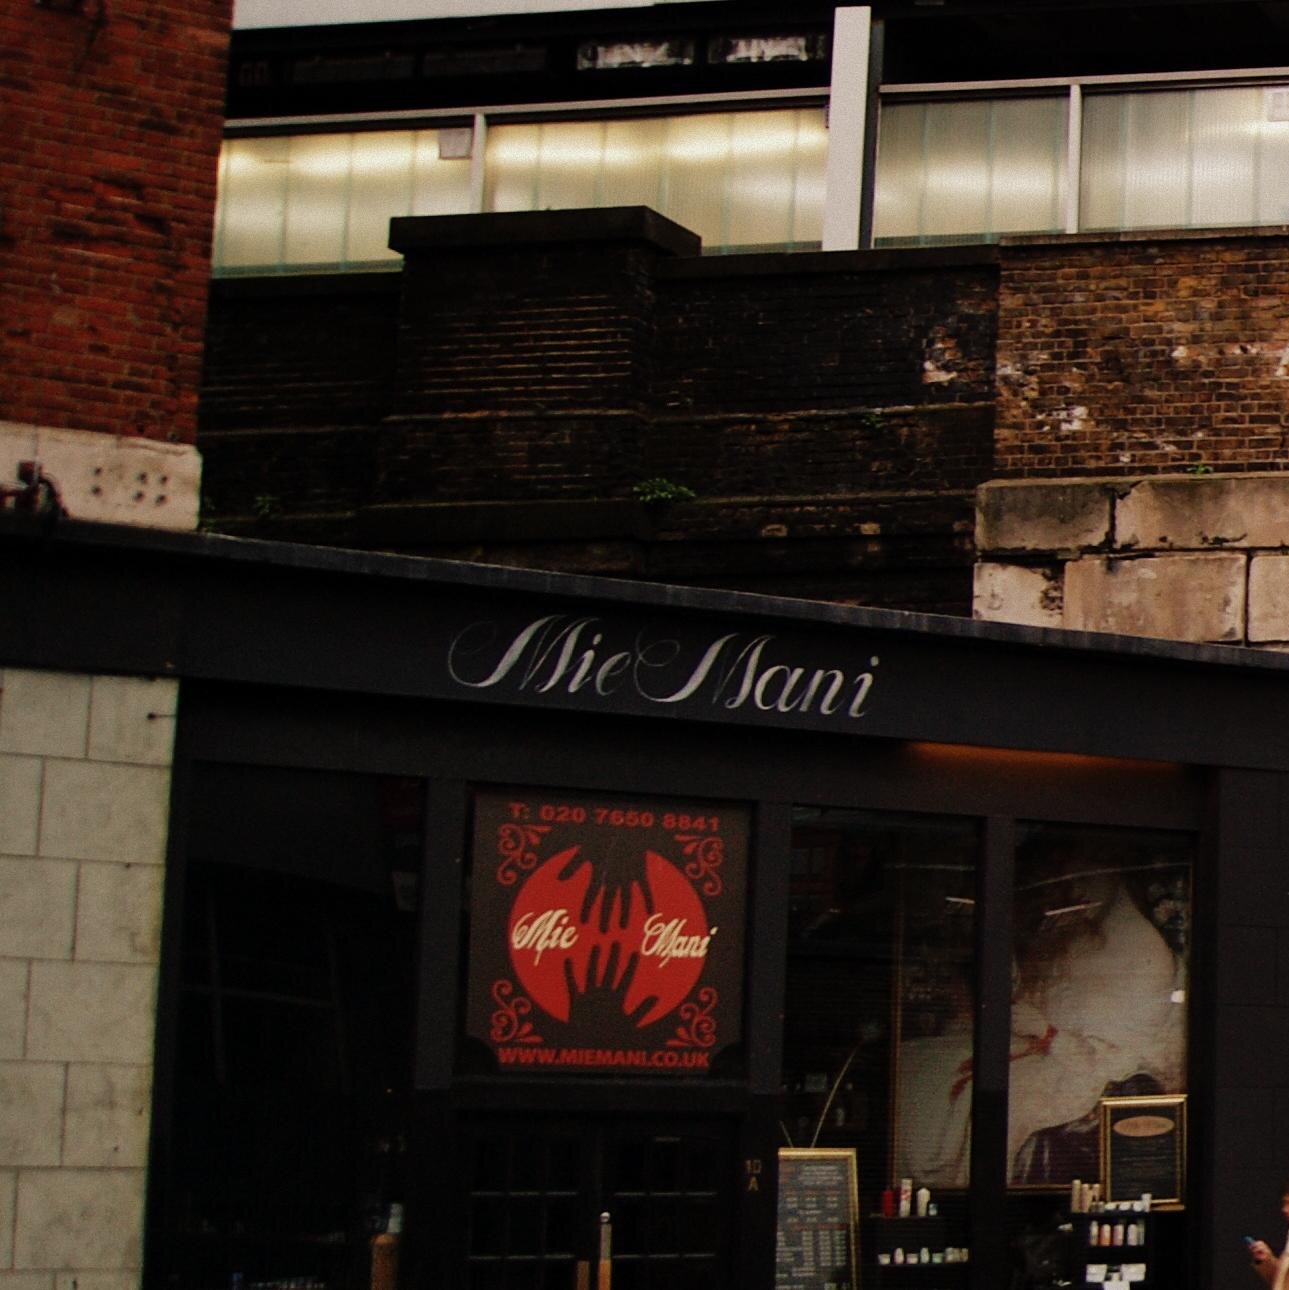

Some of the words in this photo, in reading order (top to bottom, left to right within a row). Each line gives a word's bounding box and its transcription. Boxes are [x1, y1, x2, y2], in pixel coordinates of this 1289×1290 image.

[448, 614, 632, 696] Mie
[634, 625, 879, 718] Mani
[508, 802, 530, 820] T:
[538, 804, 588, 825] 020
[595, 808, 655, 829] 7650
[662, 813, 720, 833] 8841
[511, 908, 580, 967] Mie
[640, 912, 719, 968] Mani
[498, 1047, 710, 1069] WWW.MIEMANI.CO.UK
